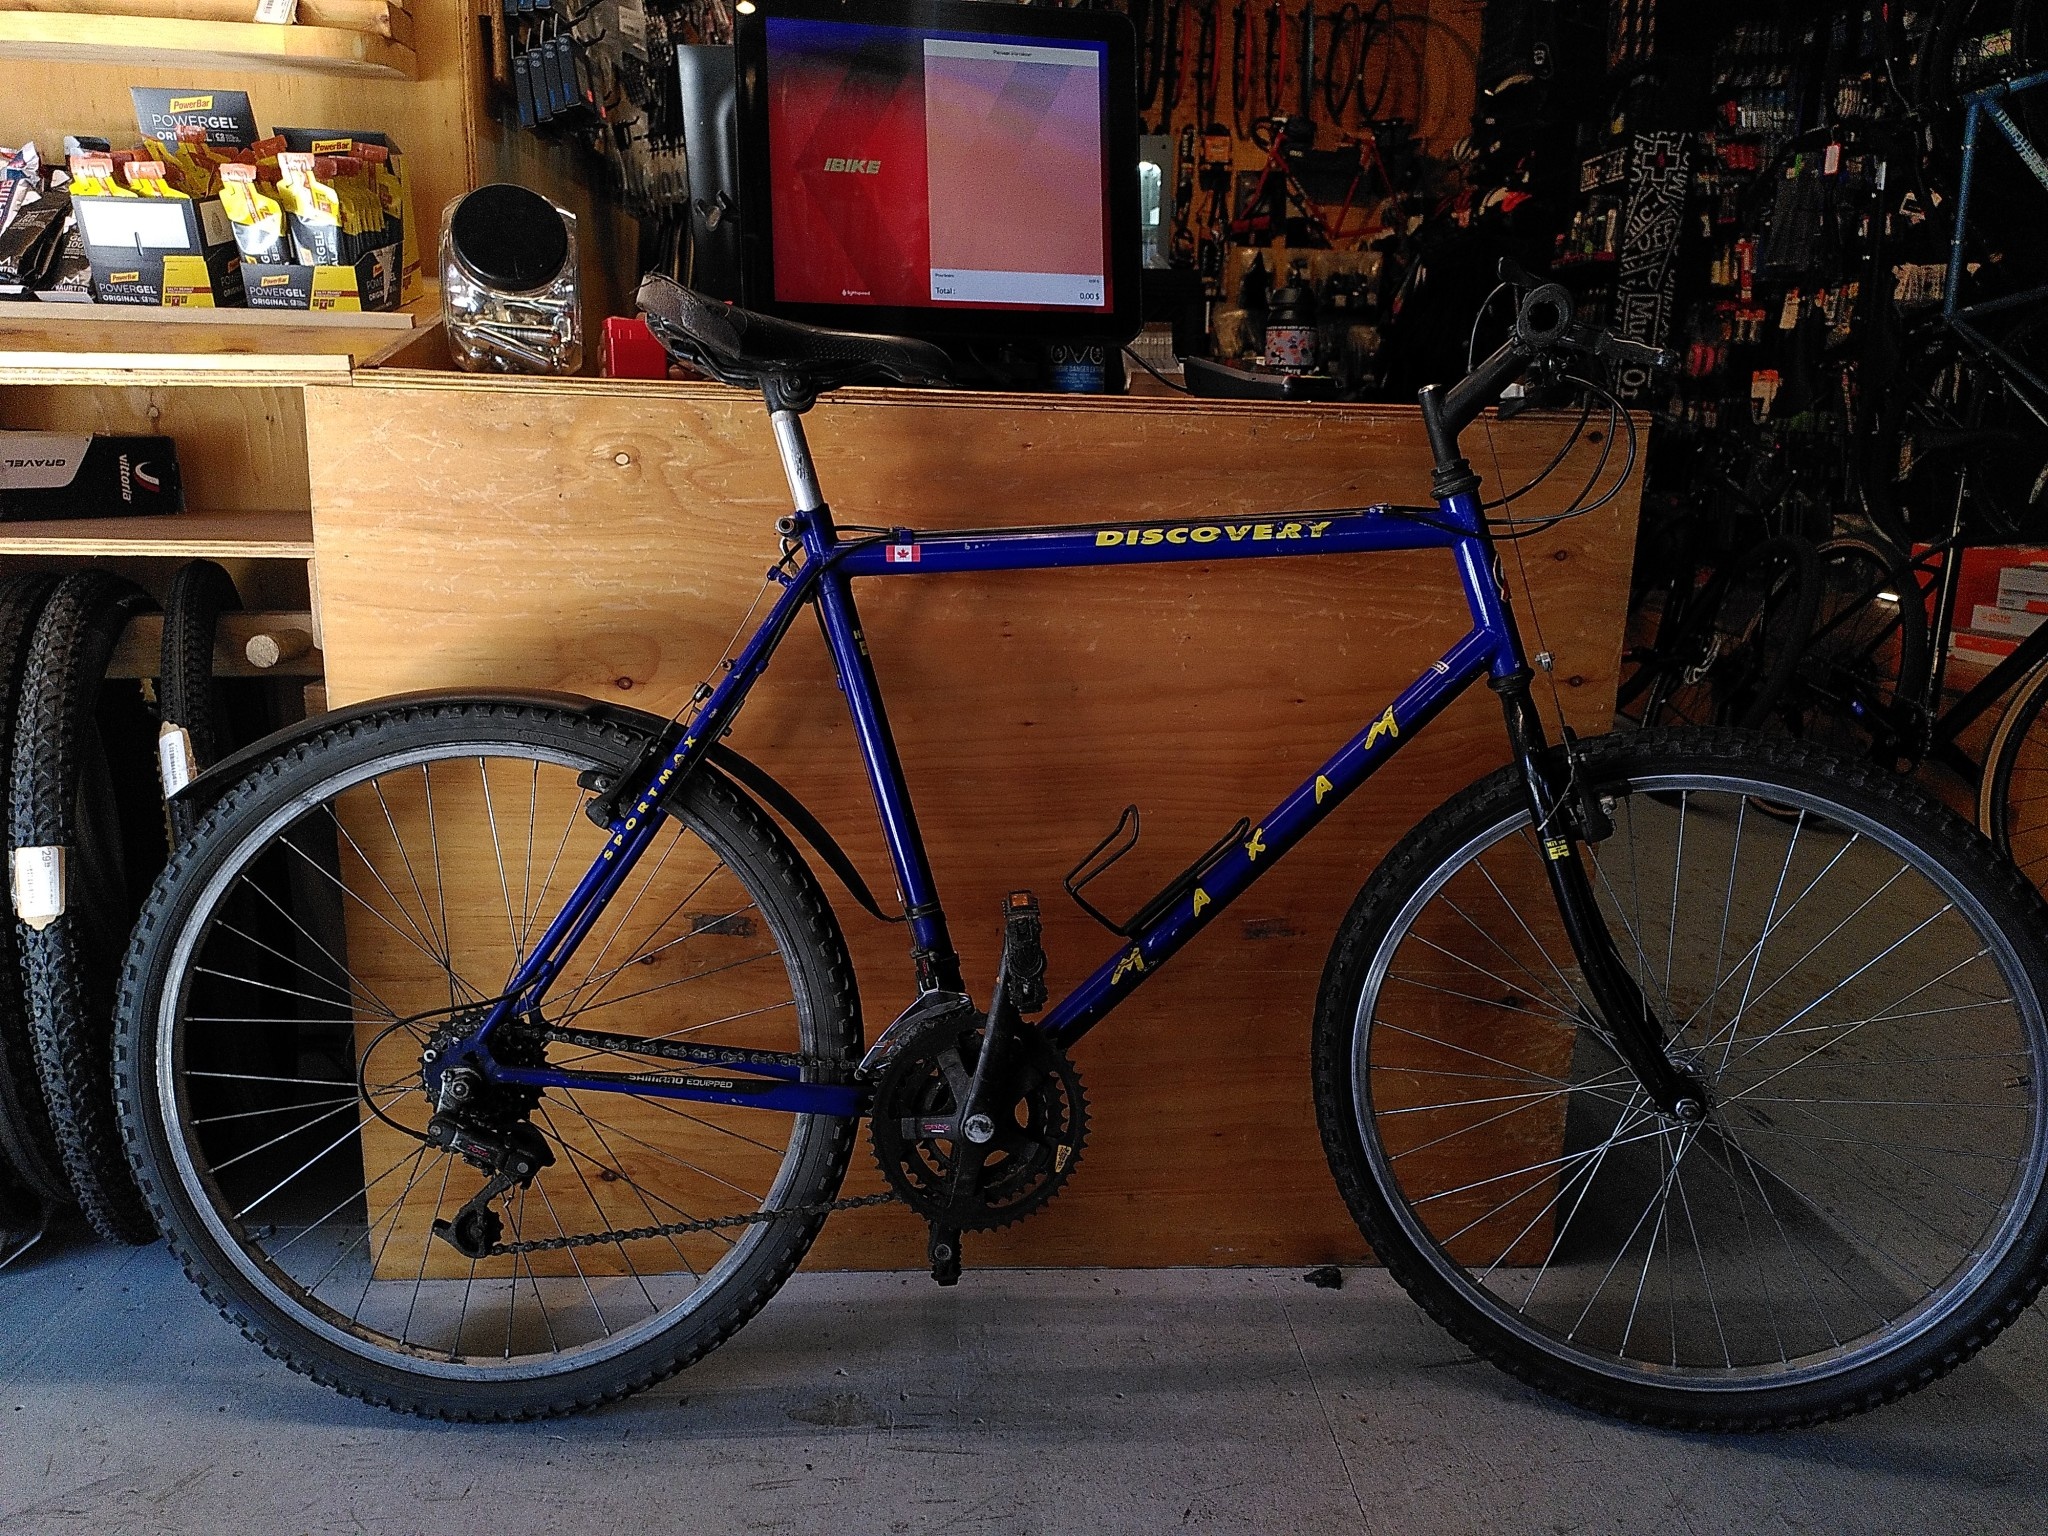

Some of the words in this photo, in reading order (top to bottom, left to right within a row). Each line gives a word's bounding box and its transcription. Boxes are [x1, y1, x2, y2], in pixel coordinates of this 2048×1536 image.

[173, 99, 210, 110] PowerBar
[151, 113, 239, 129] POWERGEL
[314, 142, 350, 151] PowerBar
[824, 157, 881, 174] IBIKE
[112, 273, 137, 281] PowerBar
[263, 277, 287, 285] PowerBar
[99, 283, 157, 294] POWERGEL
[250, 286, 306, 298] POWERGEL
[102, 295, 139, 303] ORIGINAL
[252, 298, 288, 306] ORIGINAL
[5, 459, 66, 467] GRAVEL
[118, 453, 132, 502] vittoria
[1095, 521, 1332, 546] DISCOVERY
[603, 735, 697, 861] SPORTMAX
[628, 1075, 684, 1085] SHIMANO
[686, 1079, 733, 1089] EQUIPPED
